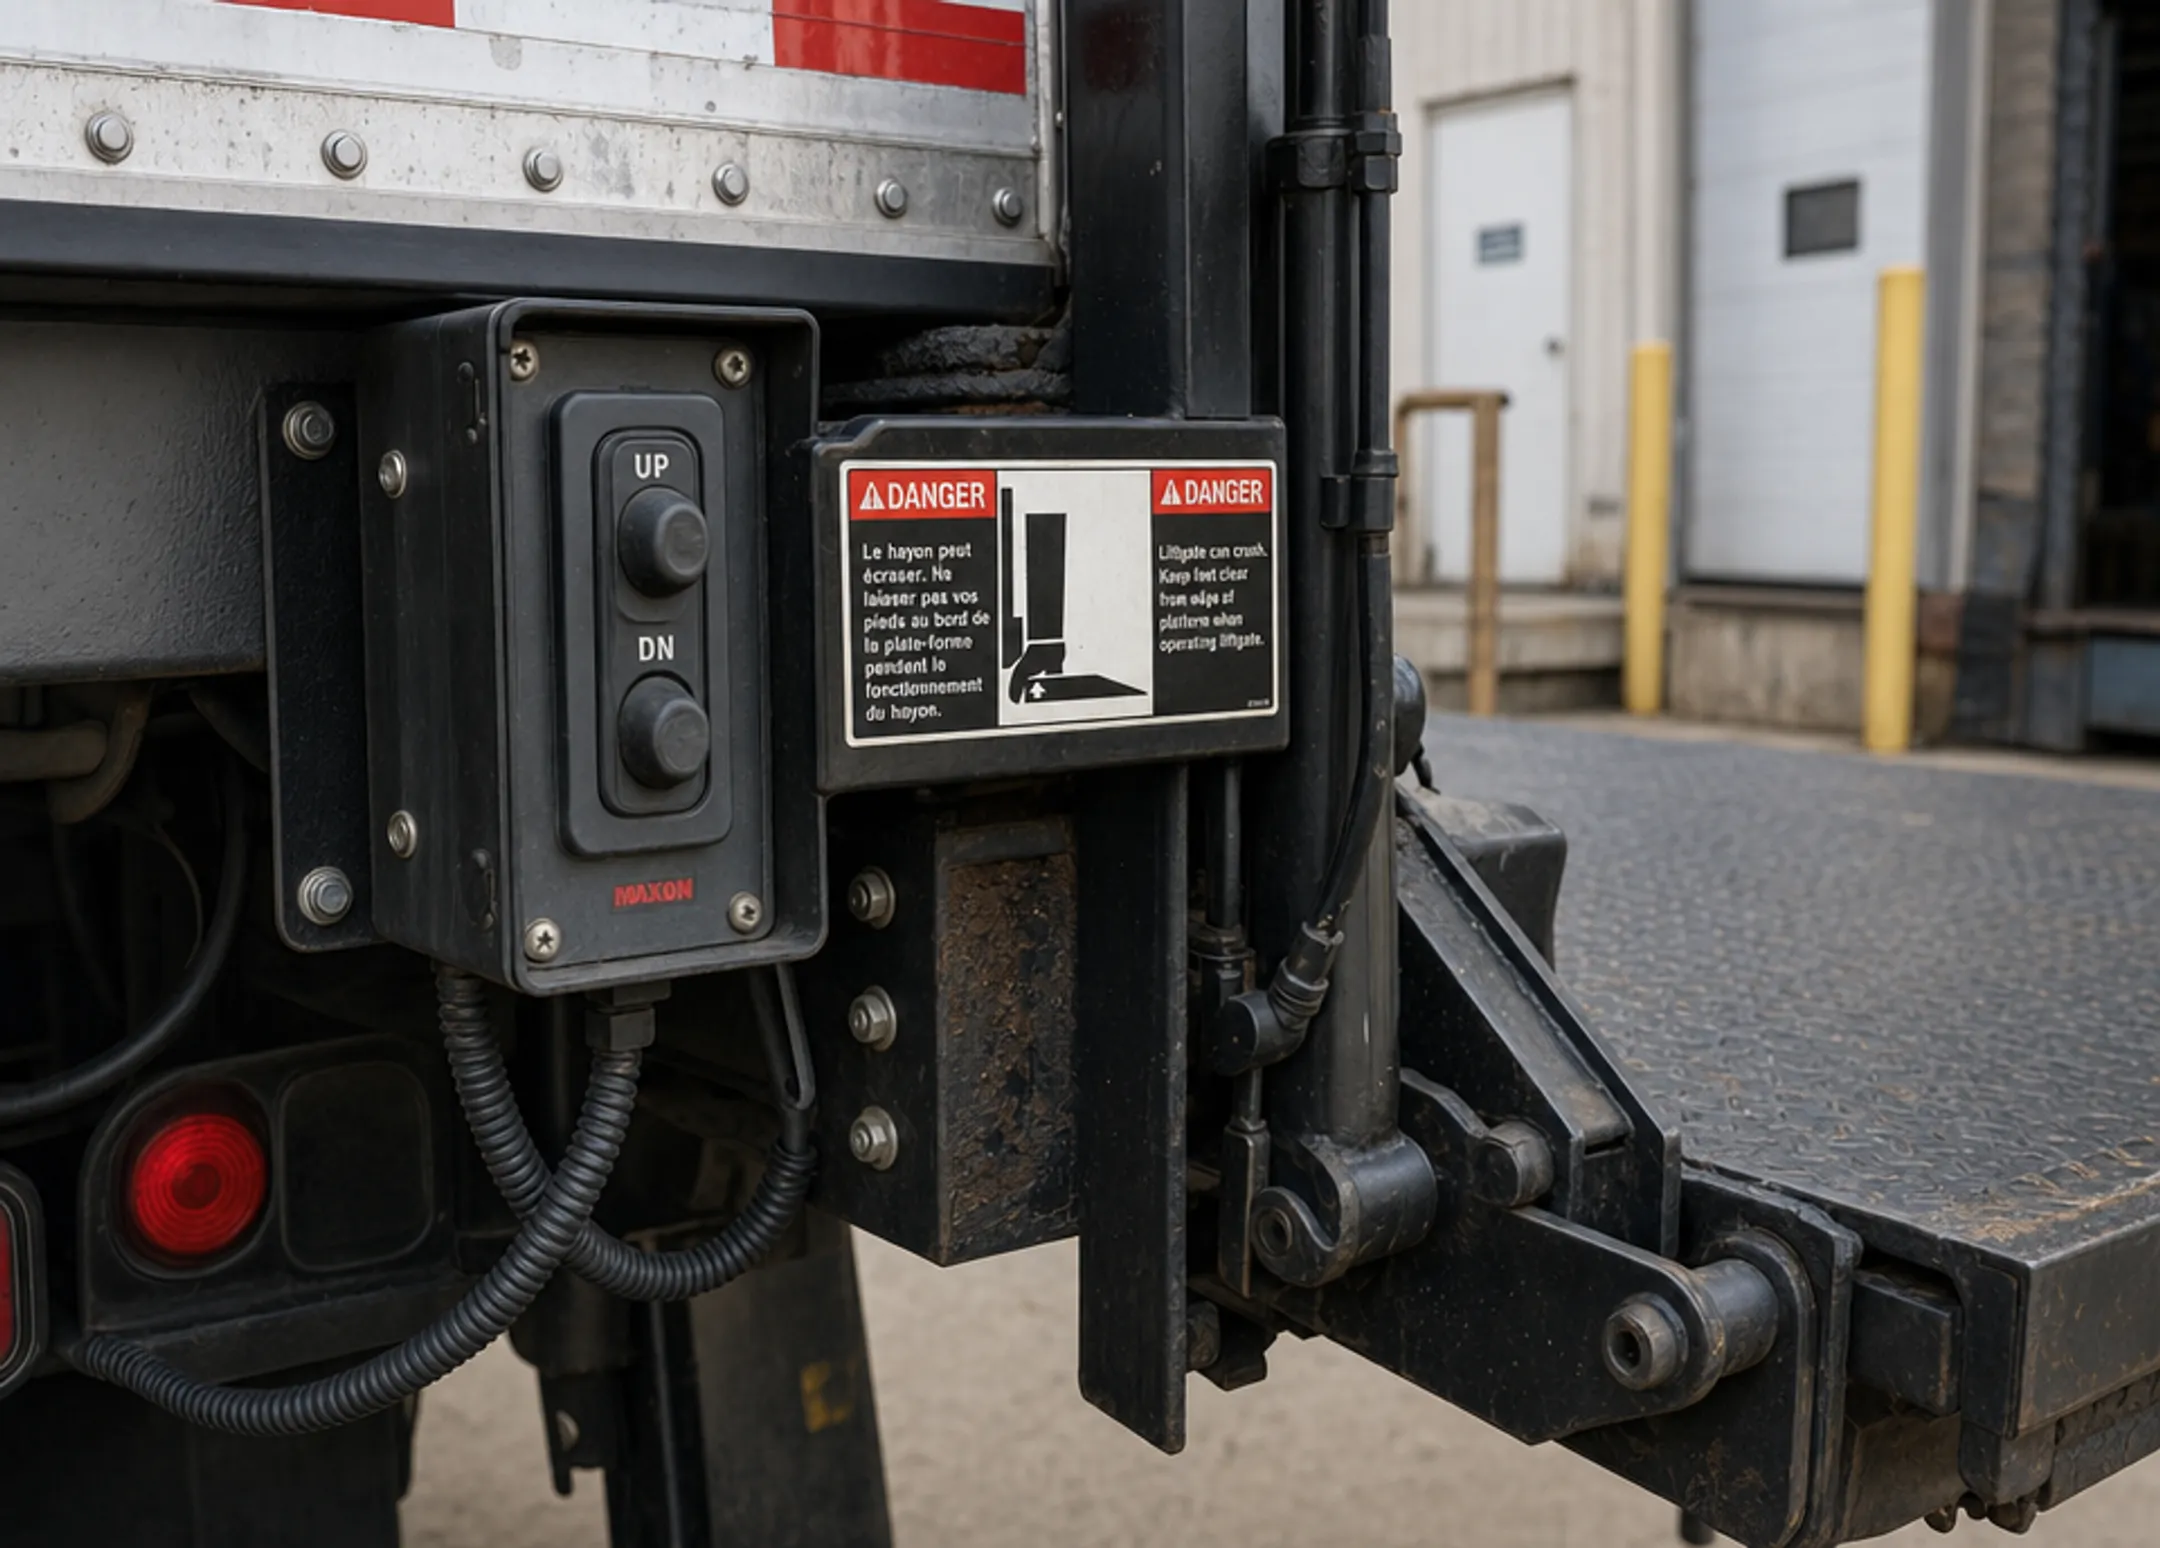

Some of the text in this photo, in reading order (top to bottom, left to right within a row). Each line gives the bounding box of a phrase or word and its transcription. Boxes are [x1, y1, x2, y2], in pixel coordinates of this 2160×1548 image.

[634, 453, 669, 478] UP
[888, 481, 985, 510] DANGER
[1185, 479, 1264, 505] DANGER
[862, 543, 883, 560] Le
[888, 543, 934, 563] hayon
[952, 591, 979, 605] vos
[638, 635, 674, 661] DN
[613, 878, 693, 907] MAXON
